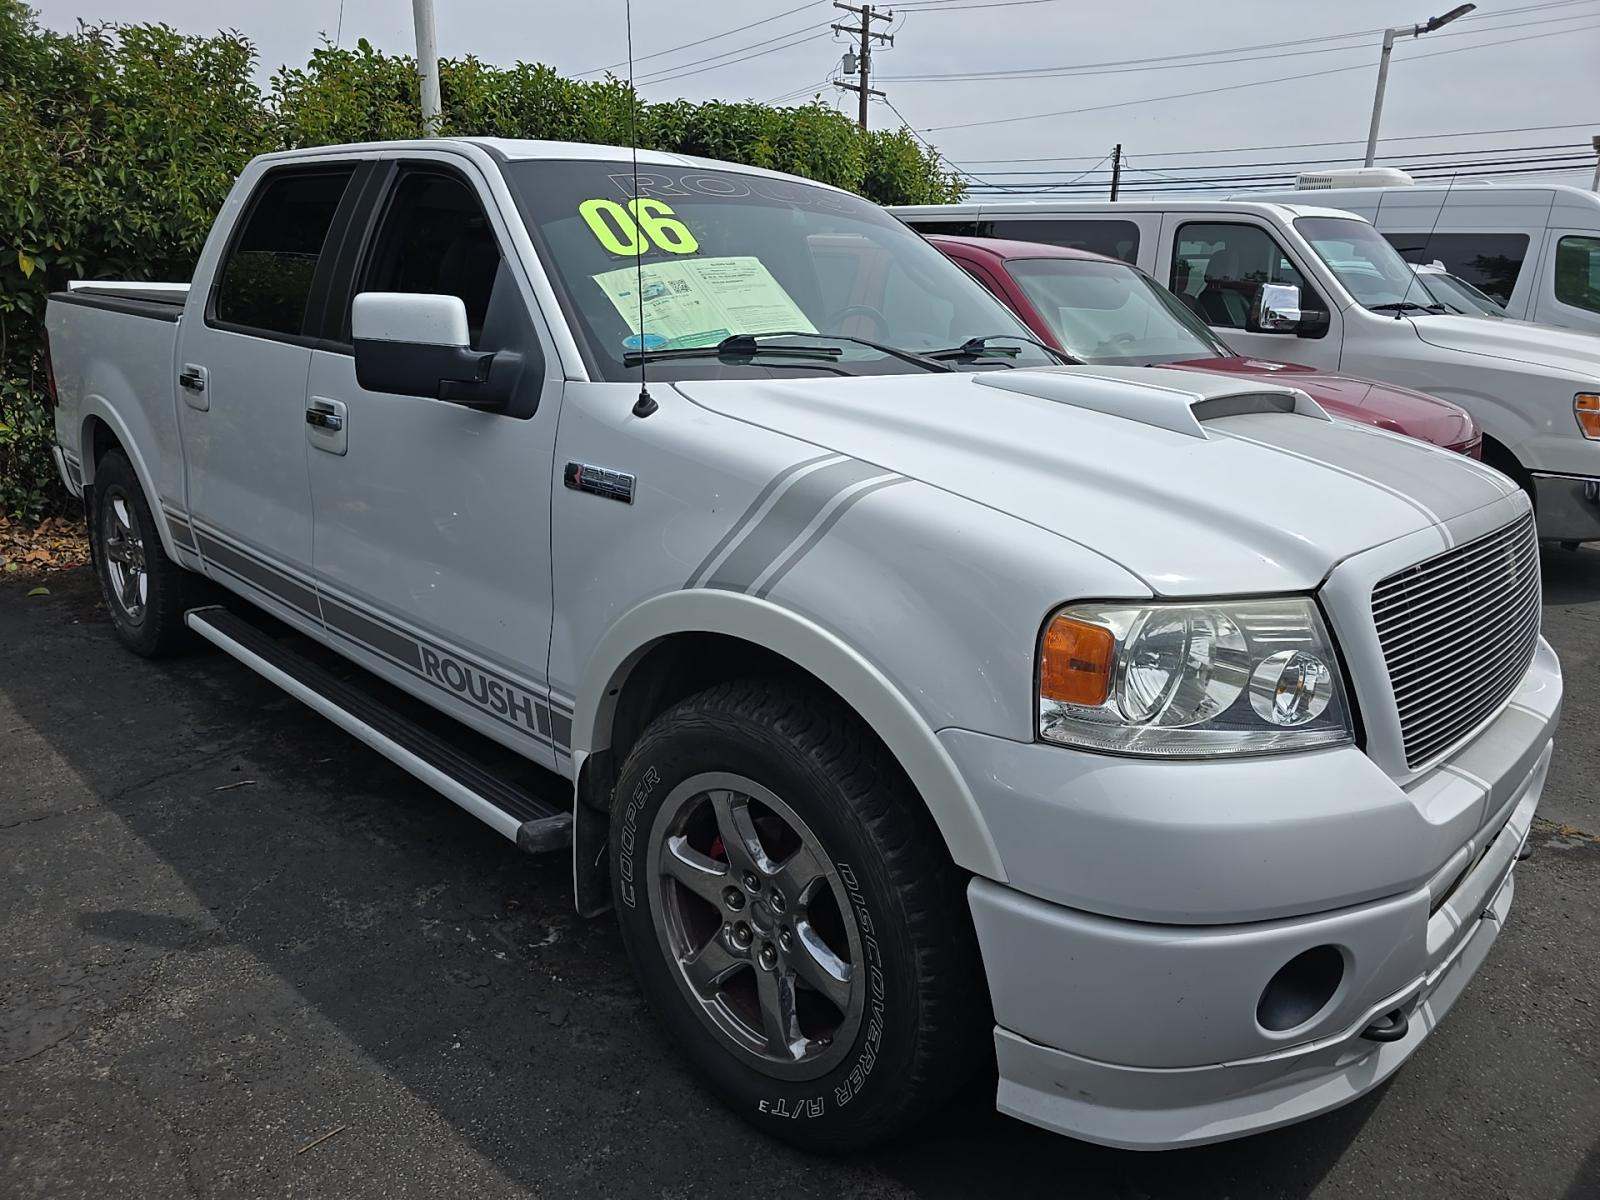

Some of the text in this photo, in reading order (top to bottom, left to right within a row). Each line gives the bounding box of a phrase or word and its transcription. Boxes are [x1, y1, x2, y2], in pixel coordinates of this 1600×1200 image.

[578, 197, 700, 256] 06
[607, 173, 860, 215] ROUS
[421, 646, 535, 731] ROUSH
[618, 765, 662, 909] COOPER
[834, 862, 888, 1107] DISCOVERER
